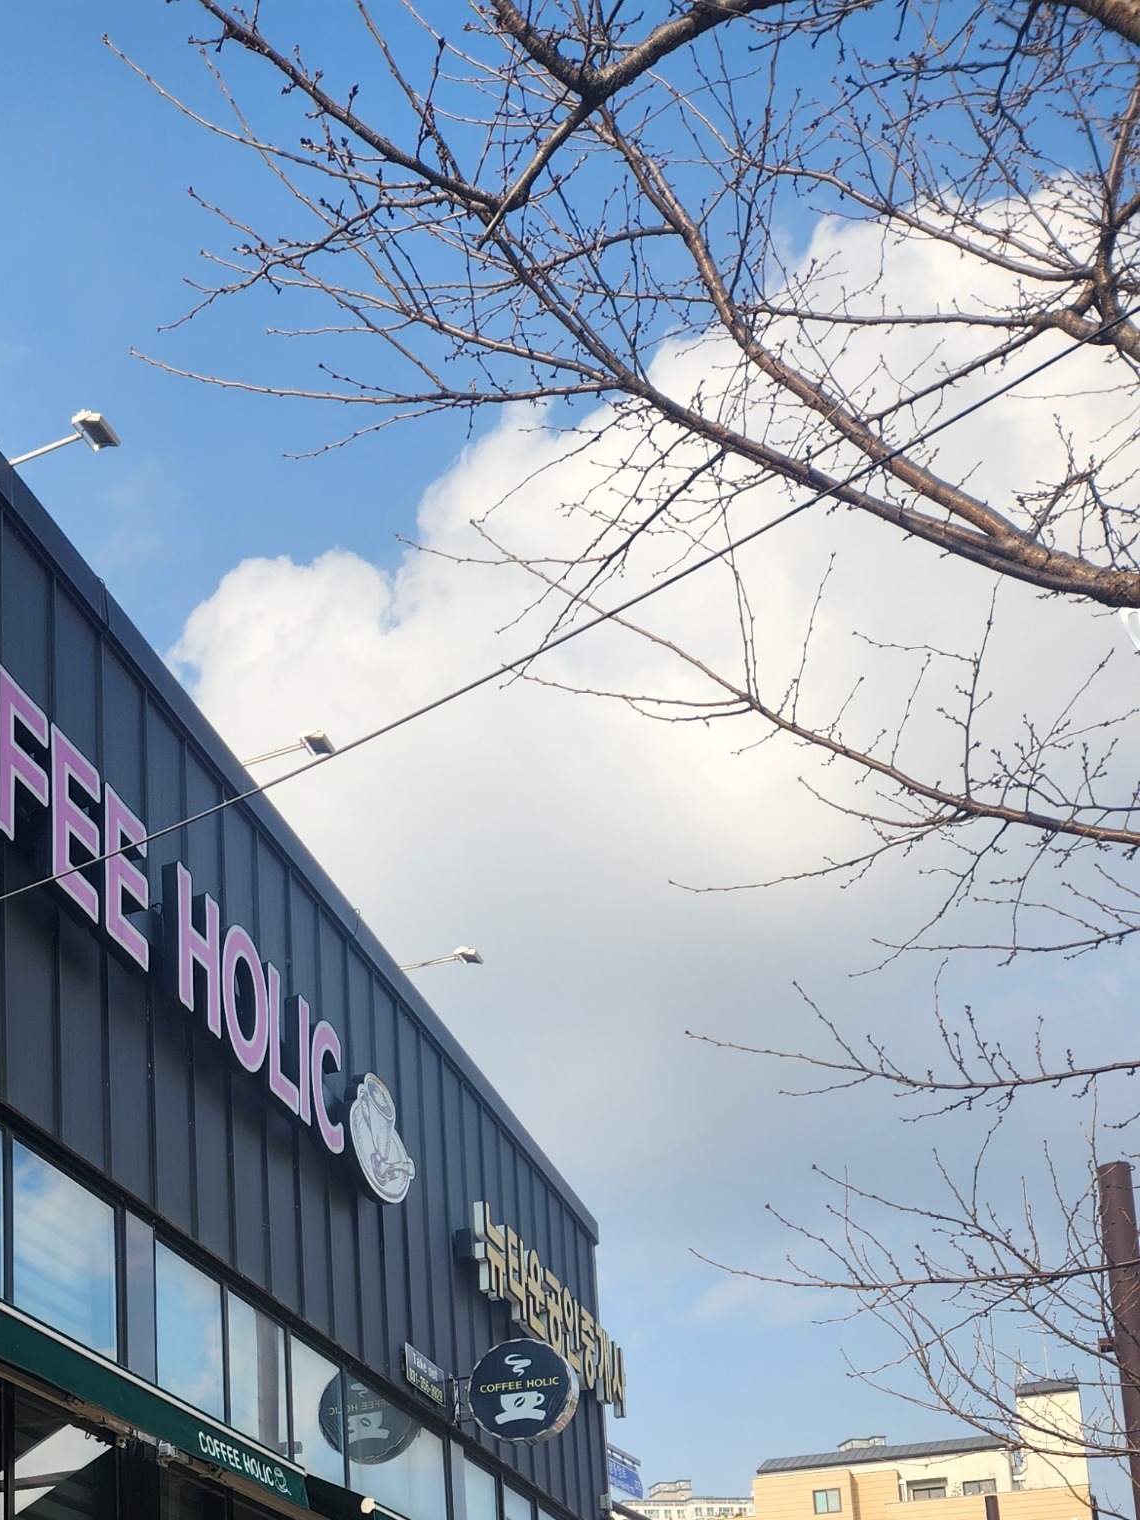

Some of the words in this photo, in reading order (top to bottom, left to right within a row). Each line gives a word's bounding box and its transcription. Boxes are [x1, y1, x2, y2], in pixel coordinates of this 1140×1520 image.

[176, 860, 344, 1155] HOLIC
[475, 1201, 627, 1418] 뉴타운공인중개사
[480, 1380, 522, 1394] COFFEE
[527, 1376, 559, 1388] HOLIC
[198, 1431, 242, 1470] COFFEE
[243, 1453, 274, 1486] HOLIC
